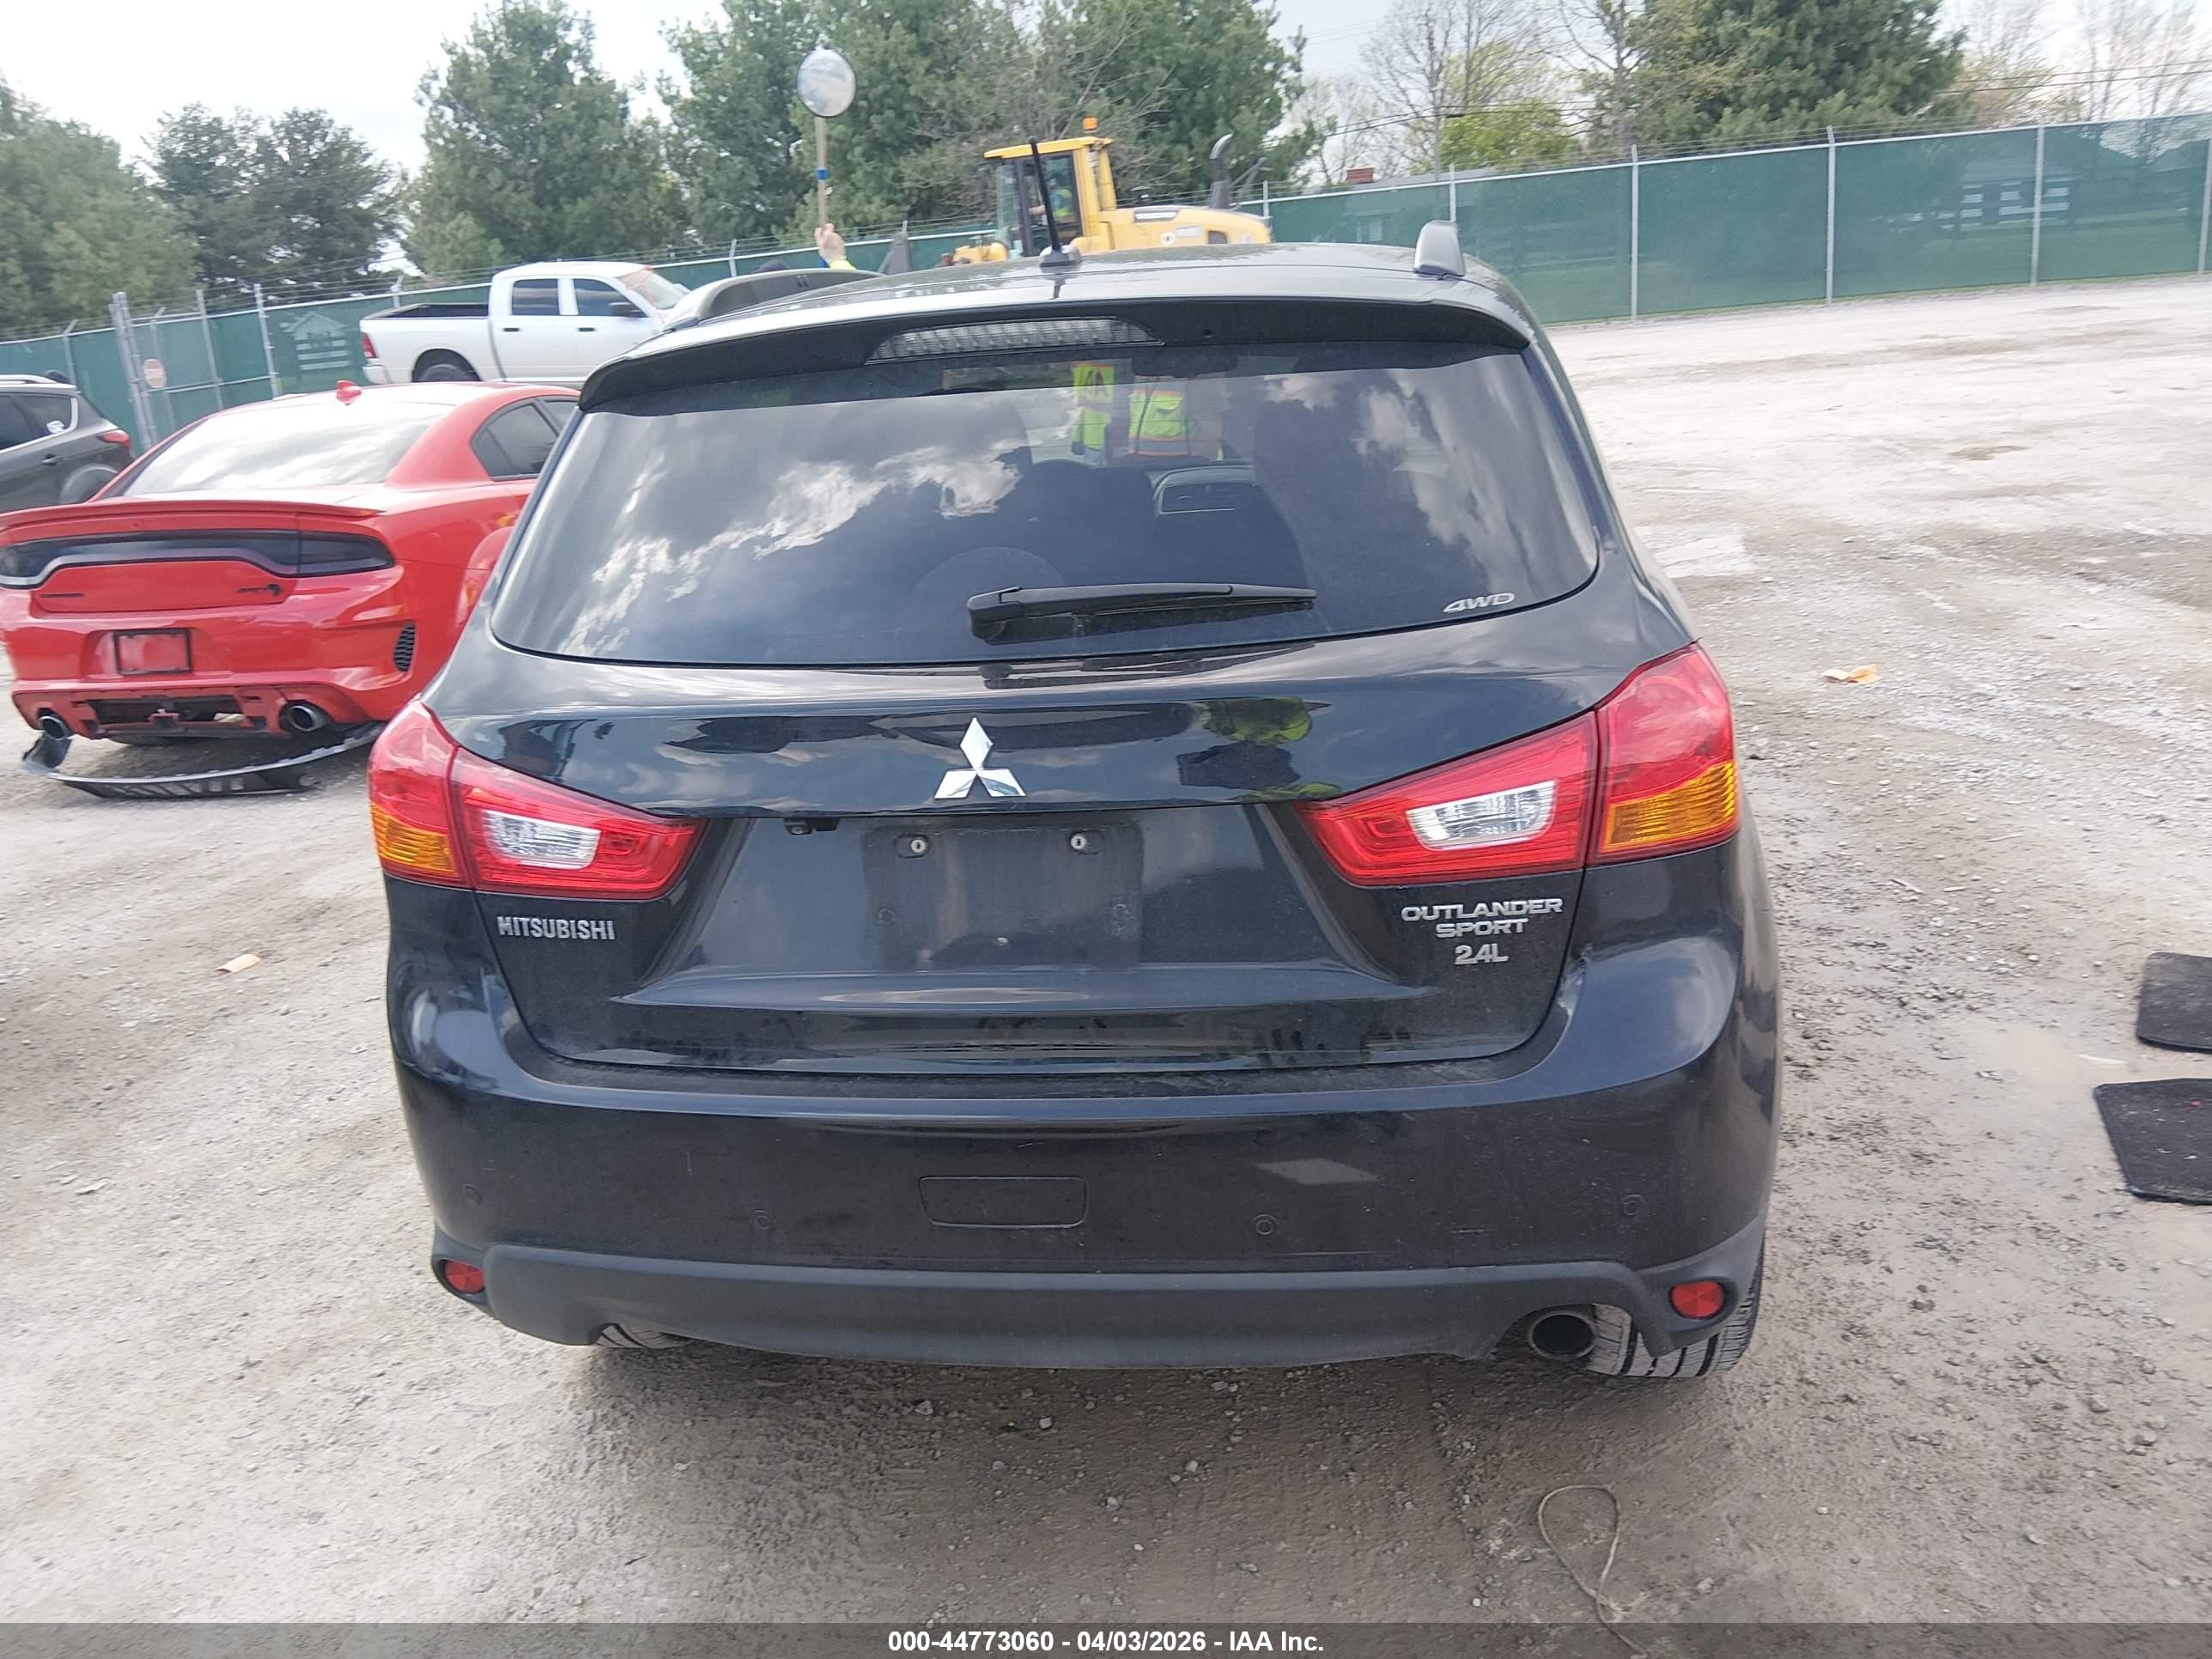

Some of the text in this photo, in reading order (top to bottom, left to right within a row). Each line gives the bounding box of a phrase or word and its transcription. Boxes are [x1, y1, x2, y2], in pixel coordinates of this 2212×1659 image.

[1443, 592, 1516, 614] 4WD
[1401, 898, 1564, 921] OUTLANDER
[496, 916, 617, 940] MITSUBISHI
[1435, 918, 1529, 939] SPORT
